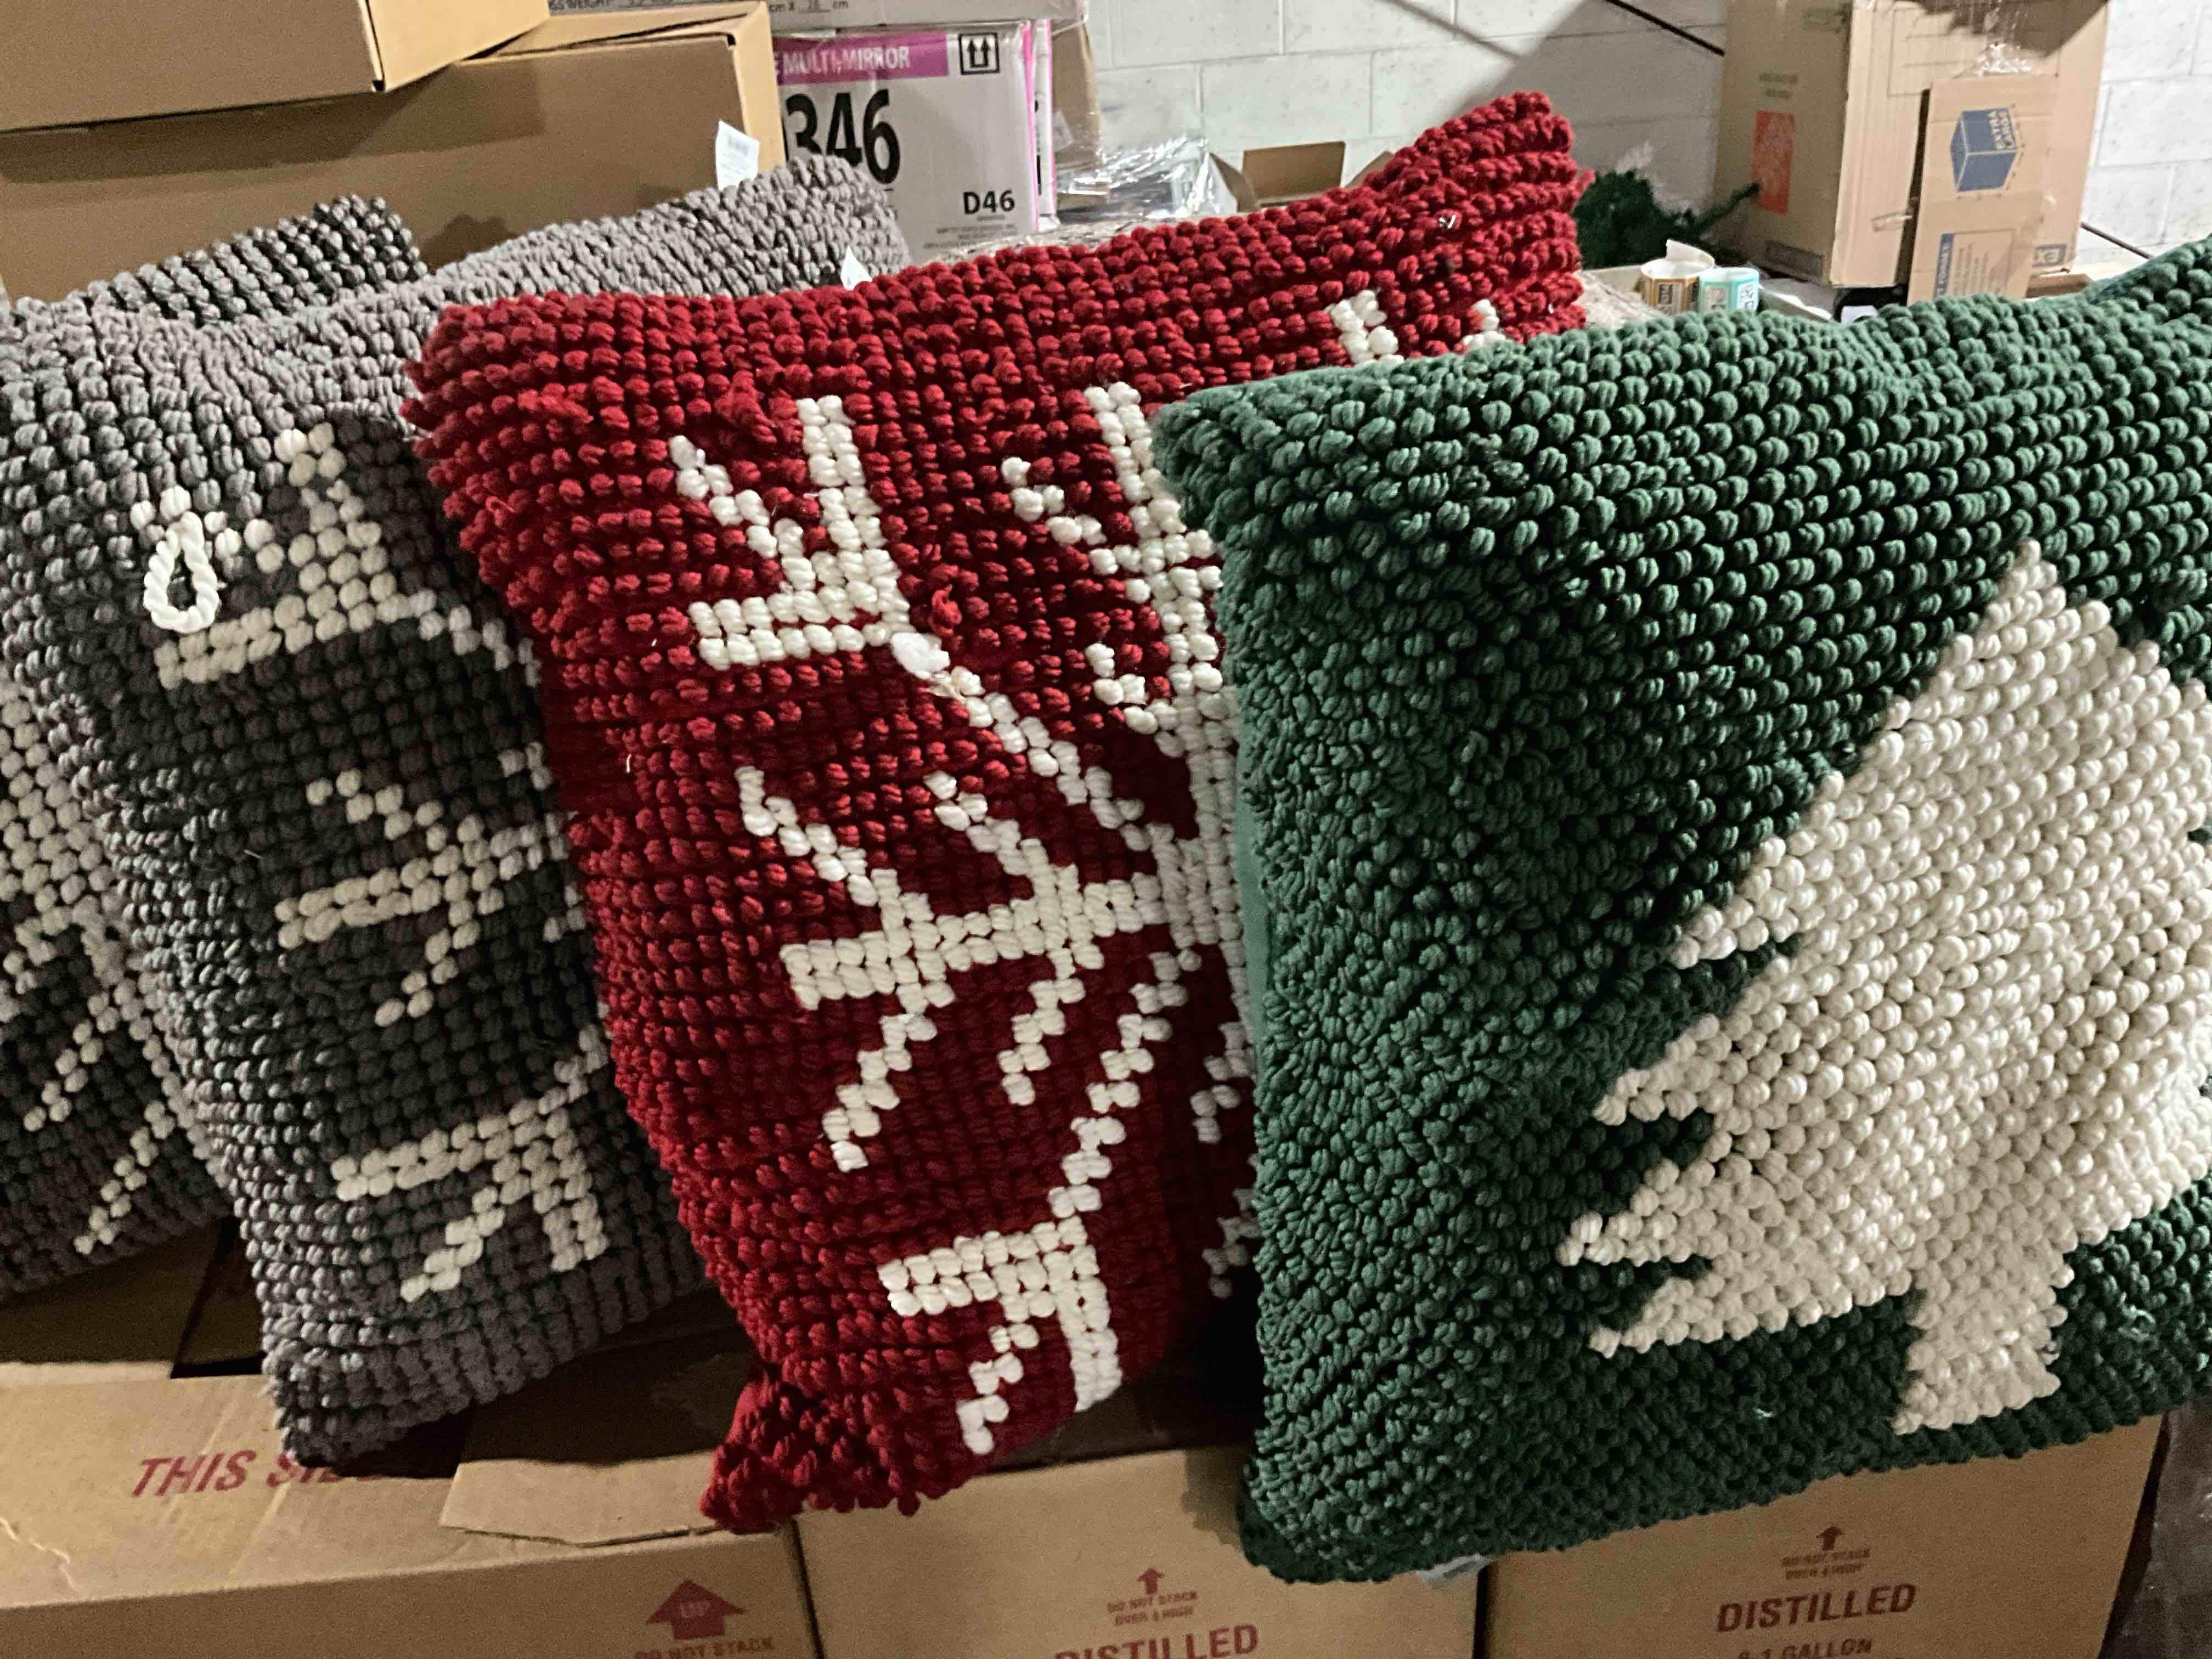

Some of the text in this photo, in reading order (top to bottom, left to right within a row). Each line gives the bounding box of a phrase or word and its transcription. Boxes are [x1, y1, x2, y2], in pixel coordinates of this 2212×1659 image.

[782, 88, 900, 184] 346
[963, 189, 1015, 215] D46
[131, 1449, 257, 1497] THIS
[1716, 1583, 1916, 1633] DISTILLED
[1053, 1623, 1259, 1659] TILLED
[1781, 1638, 1874, 1659] GALLON
